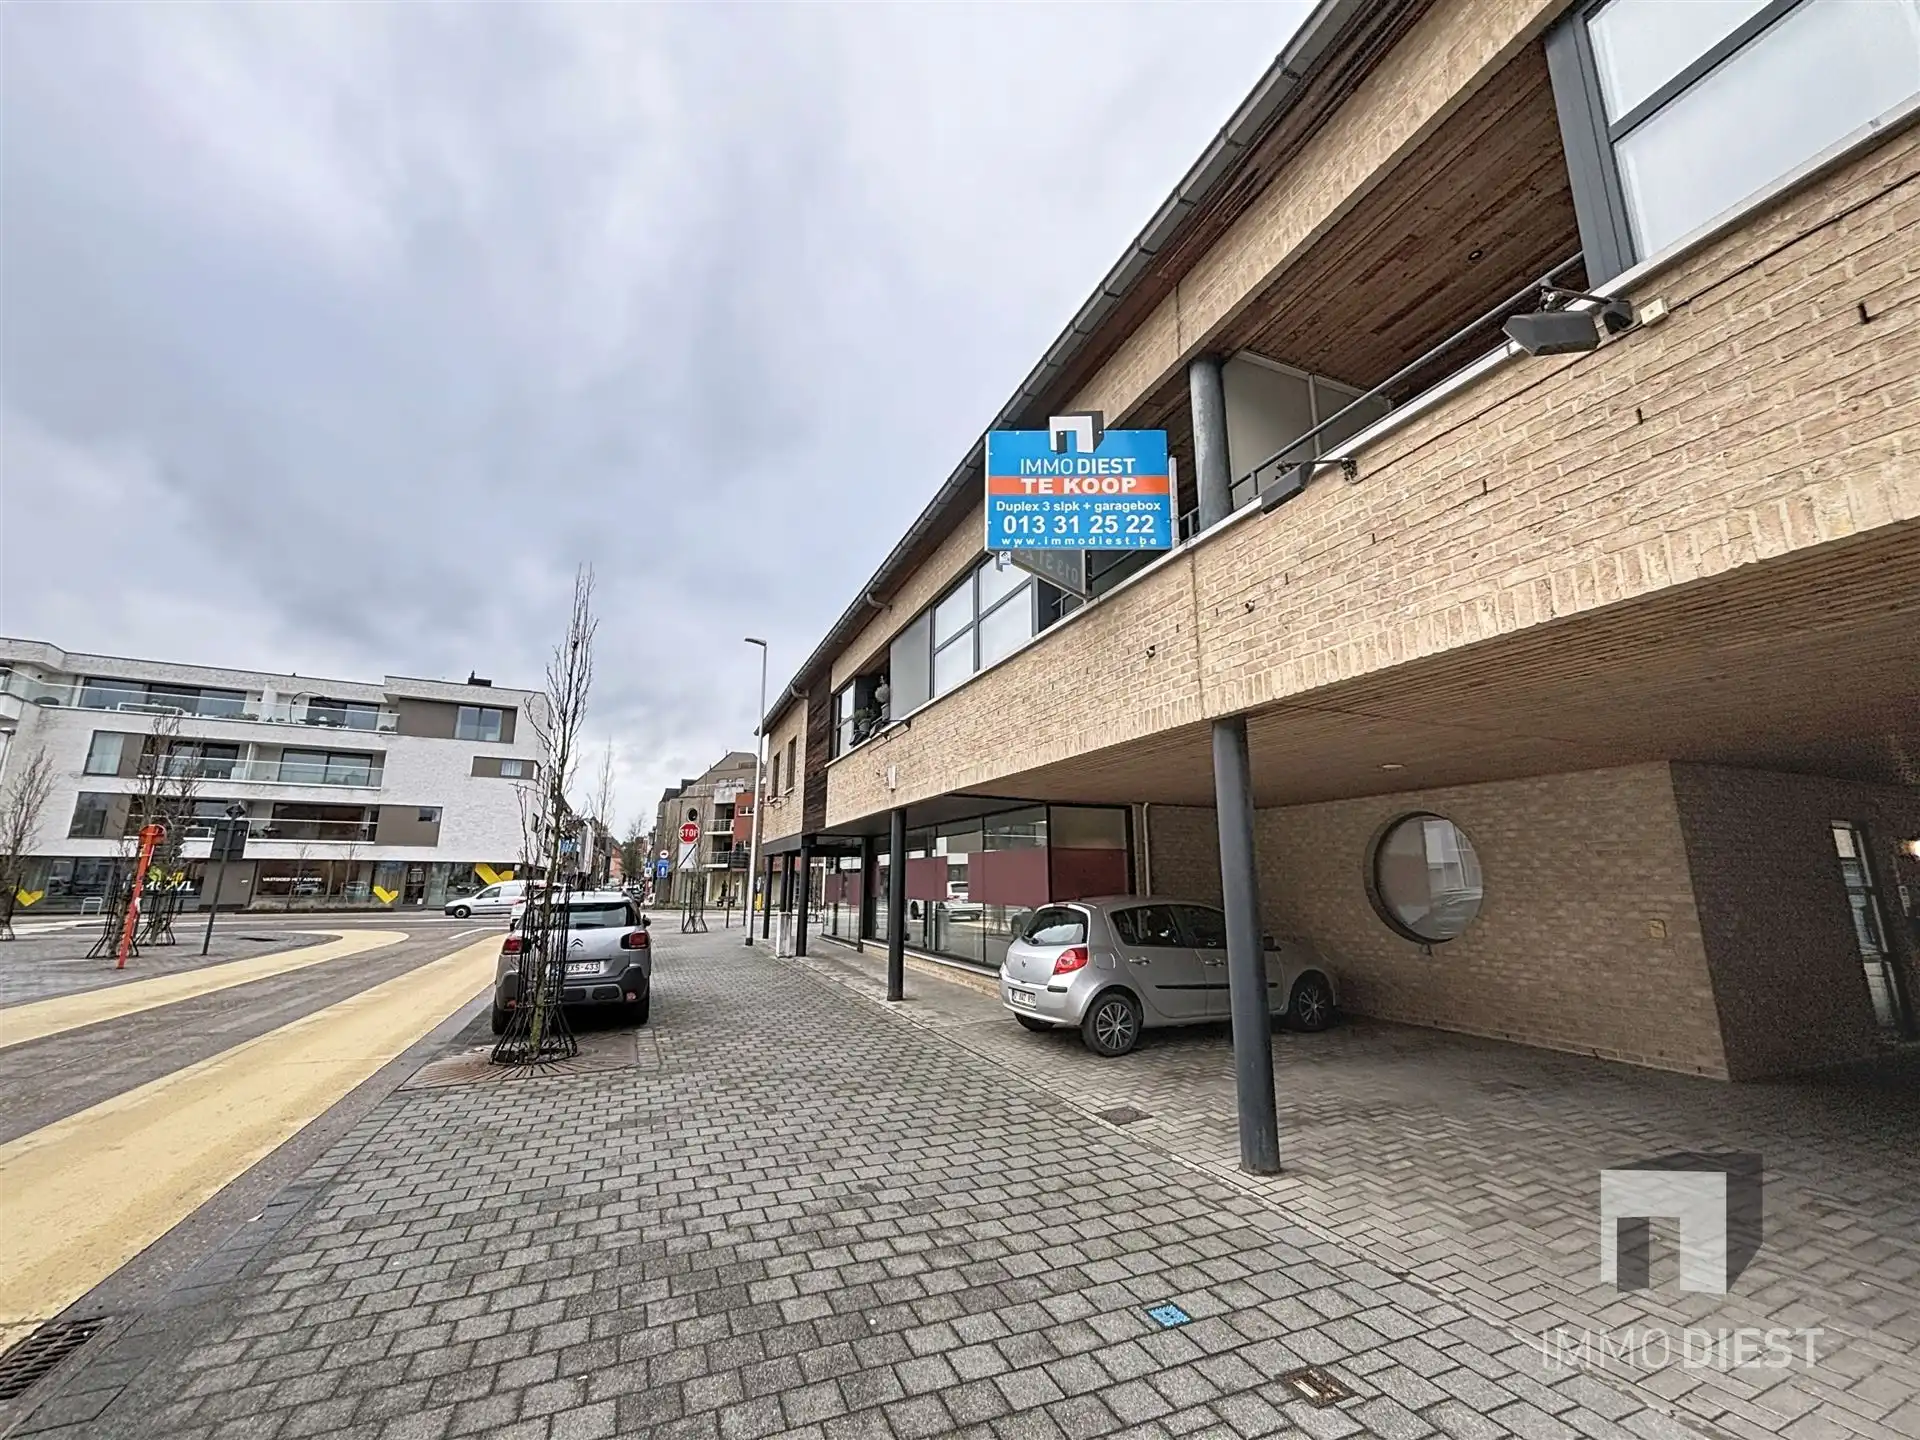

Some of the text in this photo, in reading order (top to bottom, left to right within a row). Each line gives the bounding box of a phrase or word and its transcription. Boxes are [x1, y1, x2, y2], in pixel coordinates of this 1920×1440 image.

[1020, 457, 1136, 475] IMMO DIEST
[1020, 477, 1137, 494] TE KOOP
[996, 501, 1039, 513] Duplex
[1042, 501, 1050, 511] 3
[1053, 501, 1080, 513] slpk
[1094, 501, 1161, 513] garagebox
[1003, 515, 1154, 534] 013 31 25 22
[1001, 536, 1157, 546] www.immodiest.be
[679, 828, 699, 837] STOP
